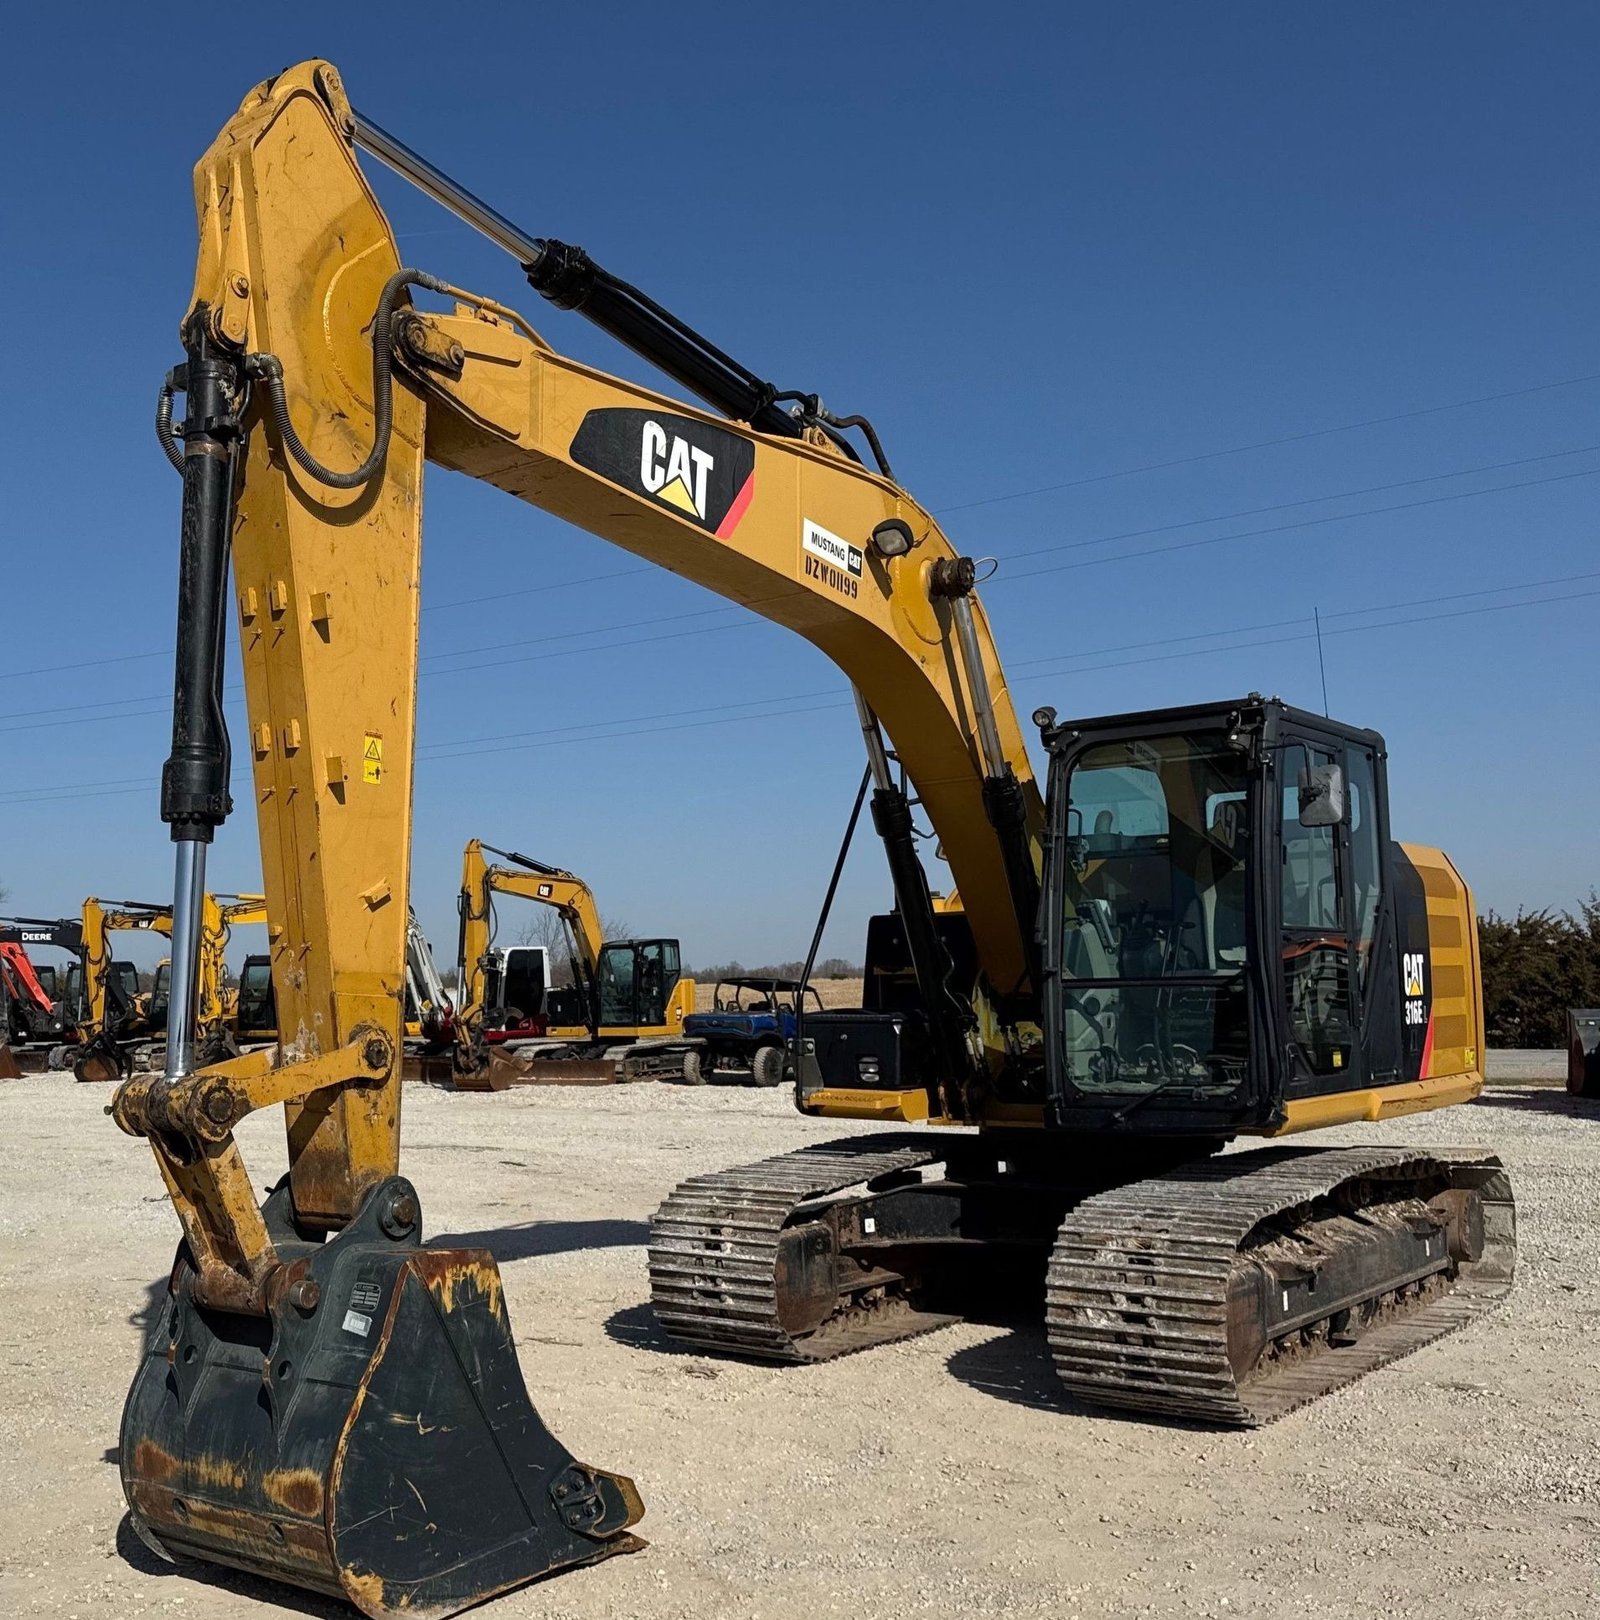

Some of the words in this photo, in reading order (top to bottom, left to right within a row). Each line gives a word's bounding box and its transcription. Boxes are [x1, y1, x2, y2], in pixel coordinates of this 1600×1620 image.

[640, 420, 713, 520] CAT
[811, 531, 845, 561] MUSTANG
[848, 551, 862, 570] CAT
[21, 932, 52, 941] DEERE
[1403, 953, 1424, 996] CAT
[1405, 1000, 1423, 1025] 316E
